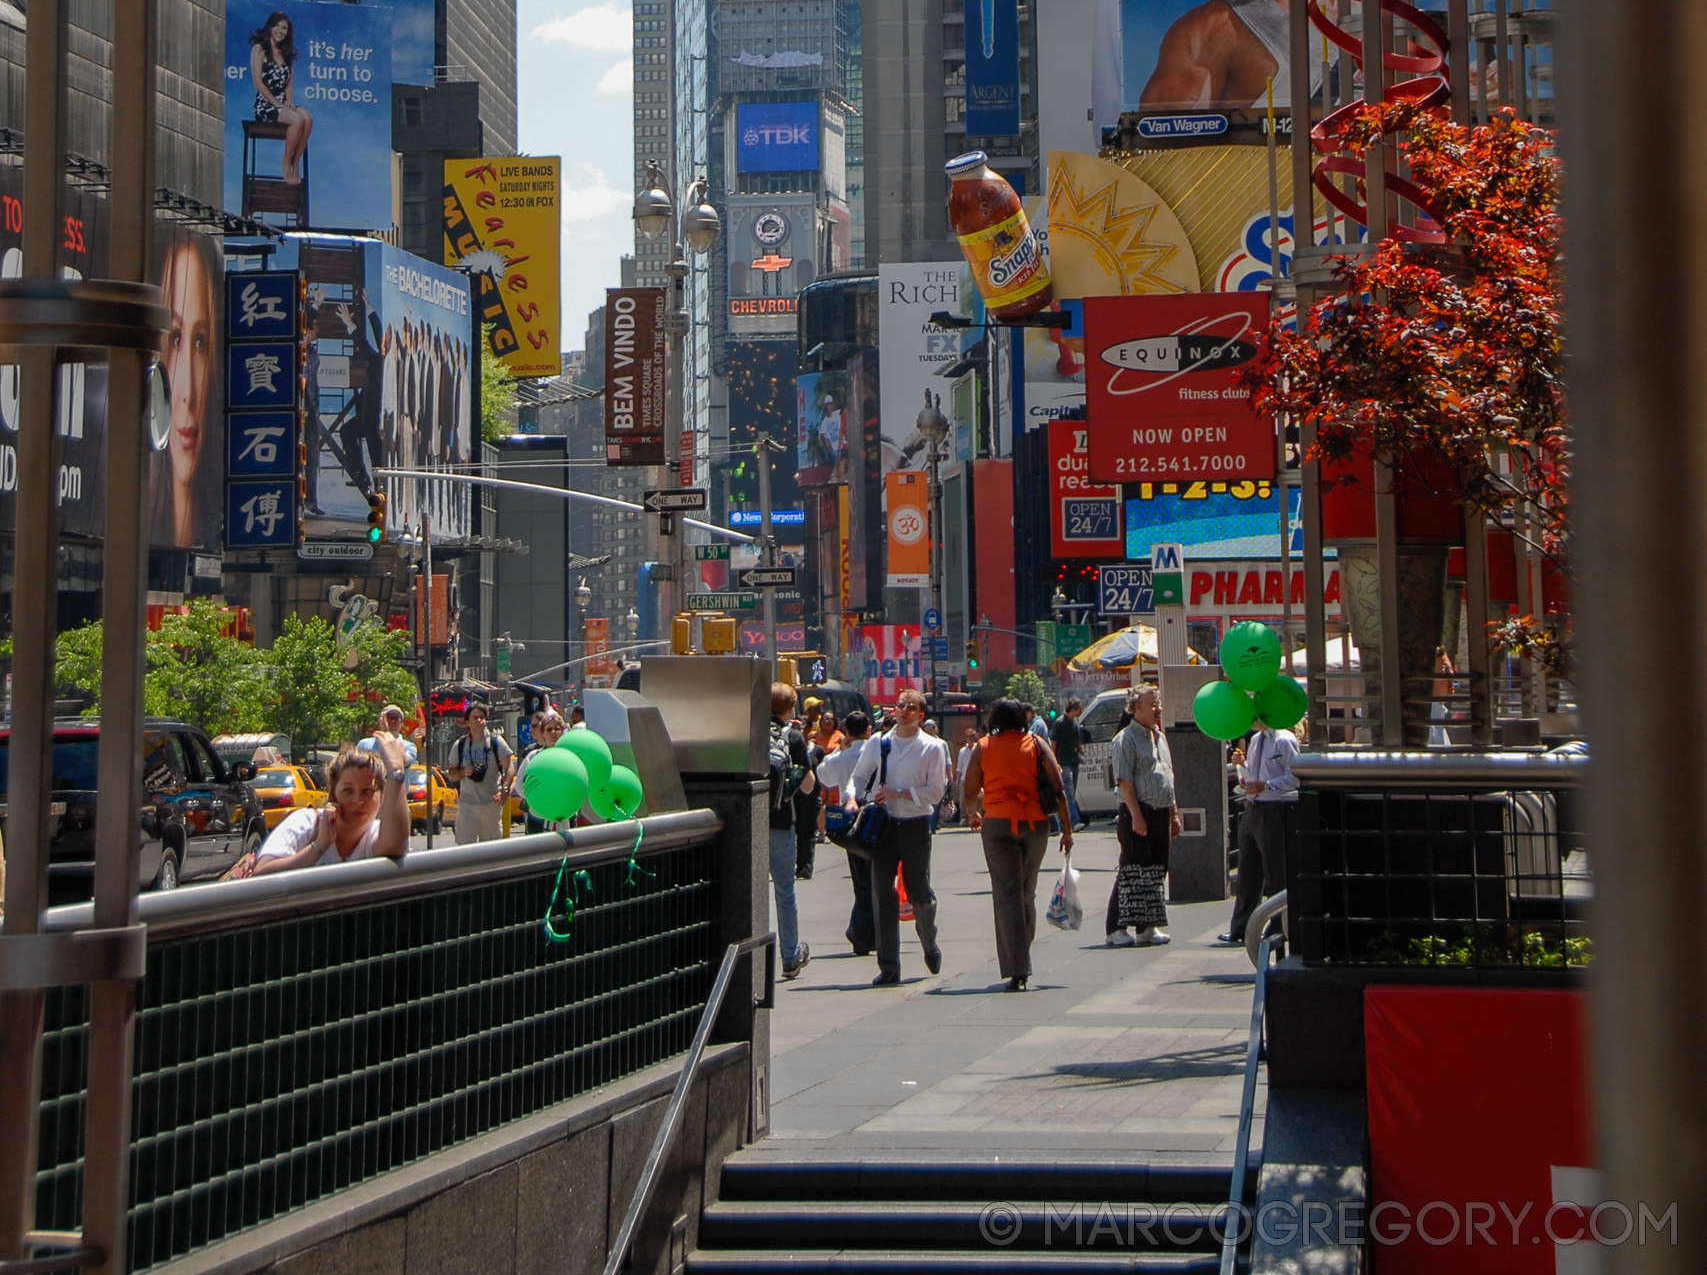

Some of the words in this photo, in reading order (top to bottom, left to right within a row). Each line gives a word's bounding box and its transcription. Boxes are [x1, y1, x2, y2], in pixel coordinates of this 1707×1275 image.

[309, 40, 336, 59] it's
[340, 43, 373, 61] her
[225, 65, 247, 80] er
[309, 62, 347, 81] turn
[352, 65, 372, 82] to
[304, 83, 378, 103] choose.
[1147, 120, 1171, 133] Van
[1173, 119, 1221, 134] Wagner
[759, 126, 811, 145] TDK
[501, 166, 520, 177] LIVE
[522, 165, 554, 176] BANDS
[500, 181, 532, 193] SATURDAY
[532, 181, 555, 192] NIGHTS
[500, 197, 525, 208] 12:30
[536, 196, 555, 208] FOX
[924, 271, 957, 282] THE
[385, 265, 398, 285] THE
[399, 265, 467, 316] BACHELORETTE
[655, 296, 664, 329] WORLD
[731, 299, 798, 314] CHEVROL
[614, 296, 637, 369] VINDO
[654, 331, 664, 350] THE
[927, 335, 958, 353] FX
[654, 351, 664, 365] OF
[918, 354, 958, 362] TUESDAYS
[1119, 346, 1241, 364] EQUINOX
[643, 358, 653, 397] SQUARE
[653, 365, 663, 427] CROSSROADS
[1178, 388, 1219, 400] fitness
[1222, 387, 1250, 400] clubs
[613, 376, 635, 429] BEM
[643, 397, 652, 427] TIMES
[1132, 429, 1173, 444] NOW
[1181, 427, 1227, 443] OPEN
[1116, 455, 1247, 473] 212.541.7000
[652, 496, 669, 506] ONE
[680, 494, 698, 505] WAY
[1070, 503, 1111, 516] OPEN
[1070, 516, 1112, 534] 24/7
[308, 546, 325, 557] city
[329, 546, 364, 556] outdoor
[698, 547, 707, 559] W
[708, 547, 718, 559] 50
[720, 545, 728, 553] ST
[747, 573, 764, 582] ONE
[771, 573, 789, 581] WAY
[1104, 570, 1153, 587] OPEN
[689, 595, 740, 609] GERSHWIN
[1105, 588, 1154, 611] 24/7
[1070, 672, 1084, 681] The
[1084, 671, 1105, 683] Jerry
